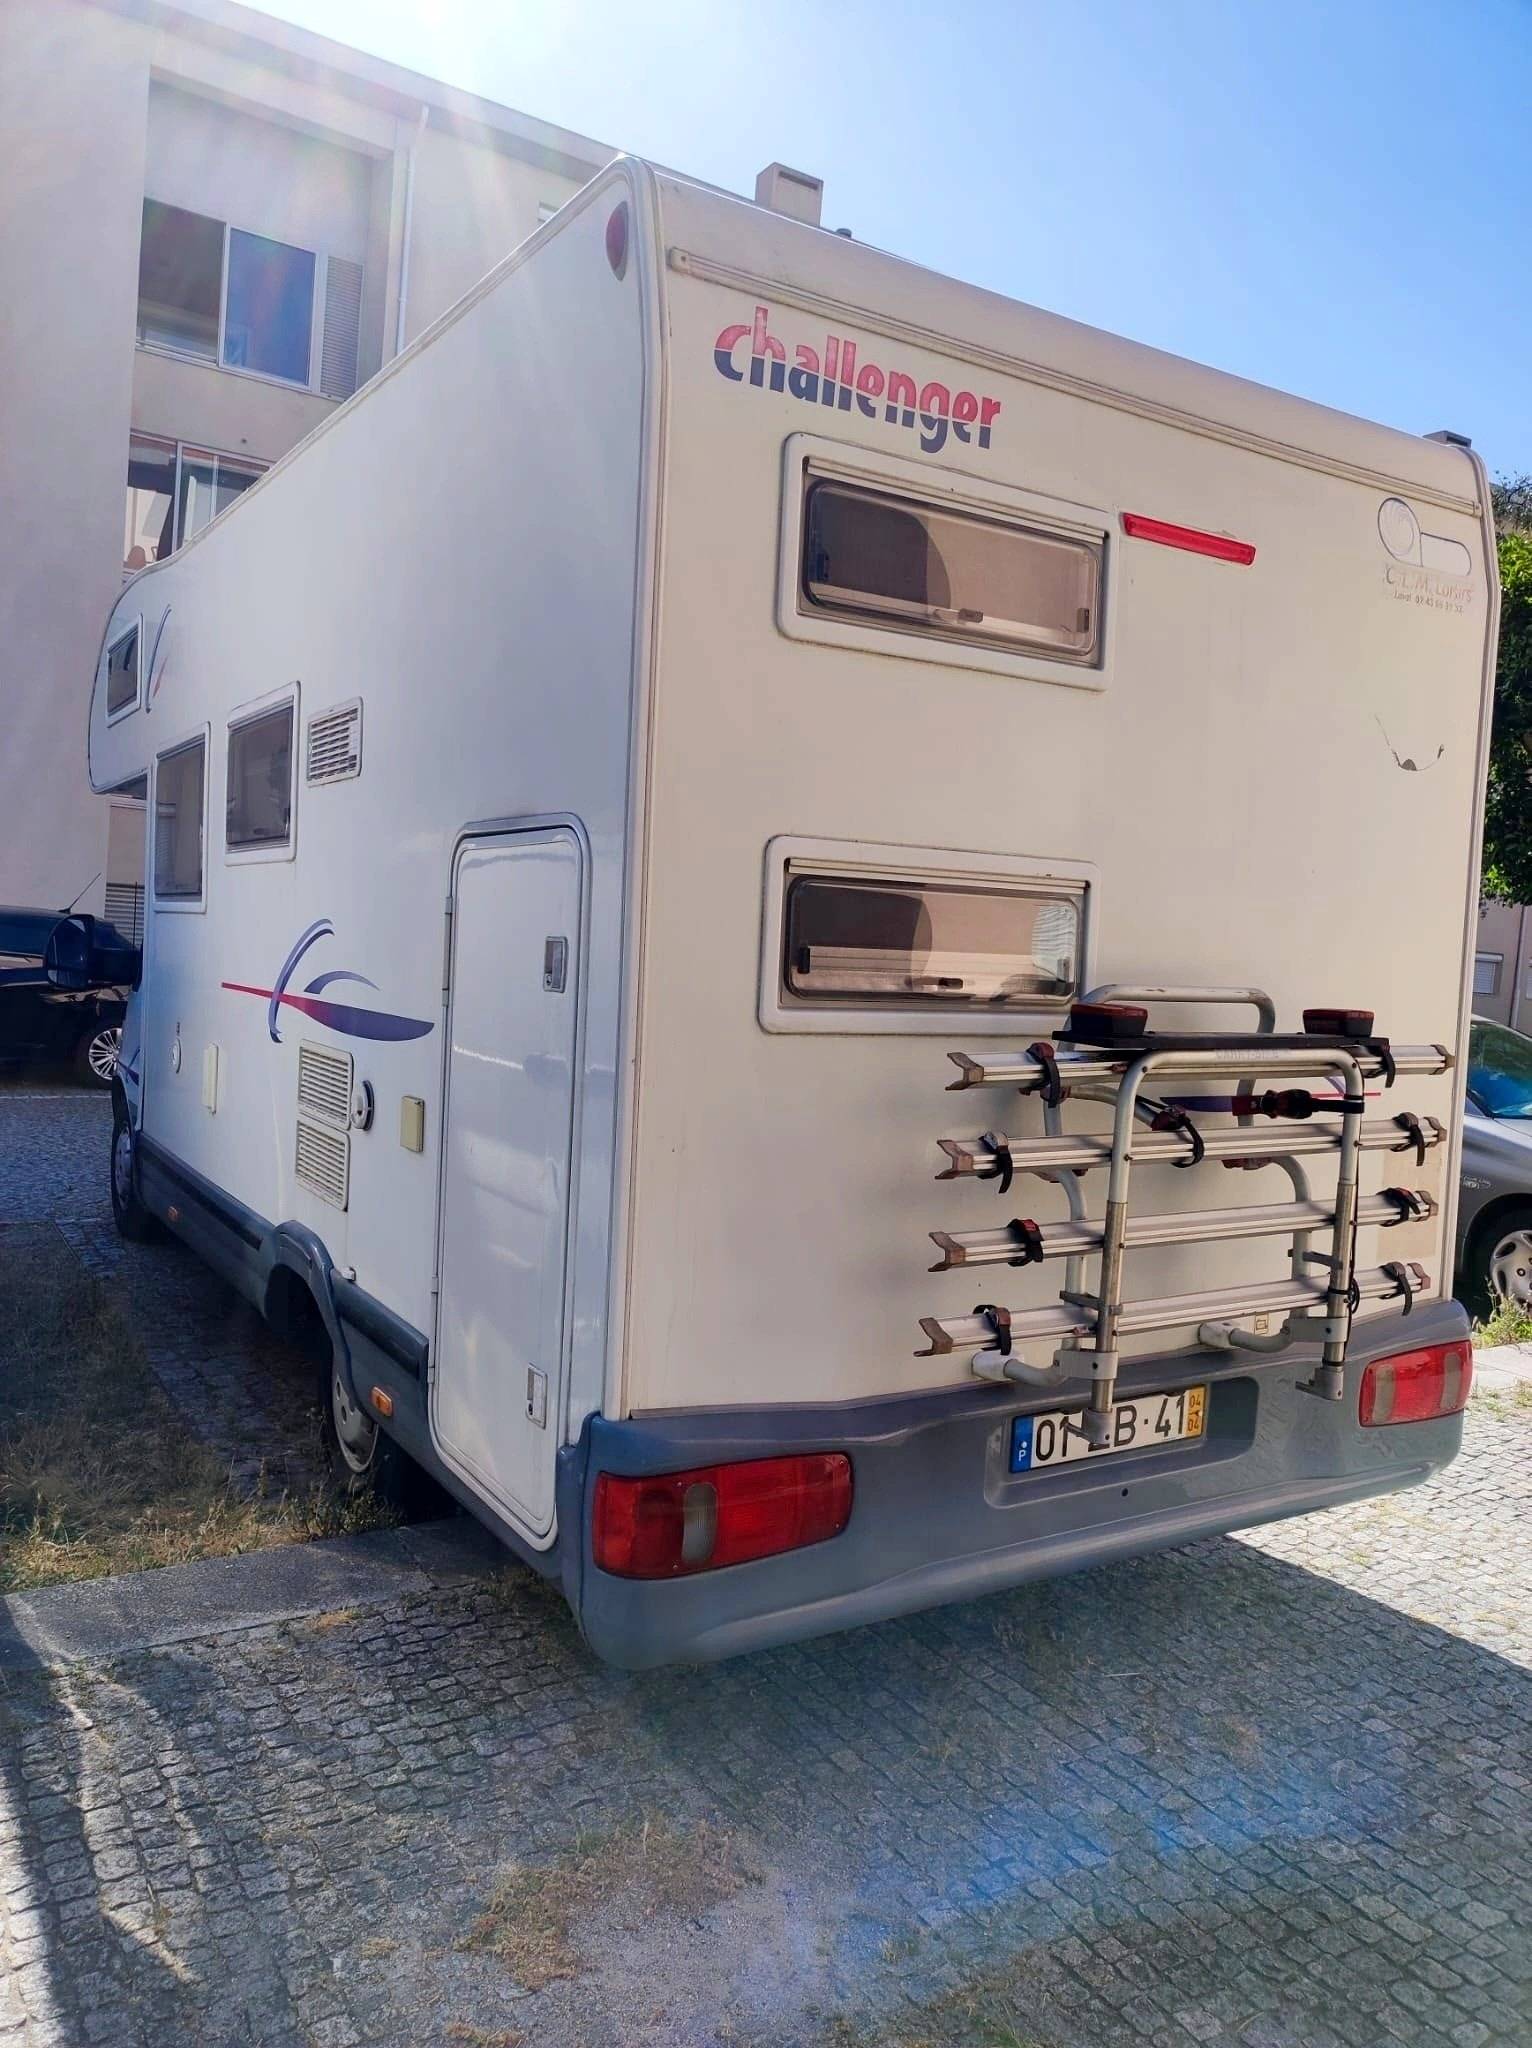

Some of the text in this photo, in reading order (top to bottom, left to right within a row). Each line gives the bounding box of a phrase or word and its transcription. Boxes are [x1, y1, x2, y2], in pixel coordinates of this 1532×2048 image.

[1188, 1394, 1201, 1407] 04
[1187, 1419, 1200, 1432] 04
[1018, 1449, 1027, 1462] P
